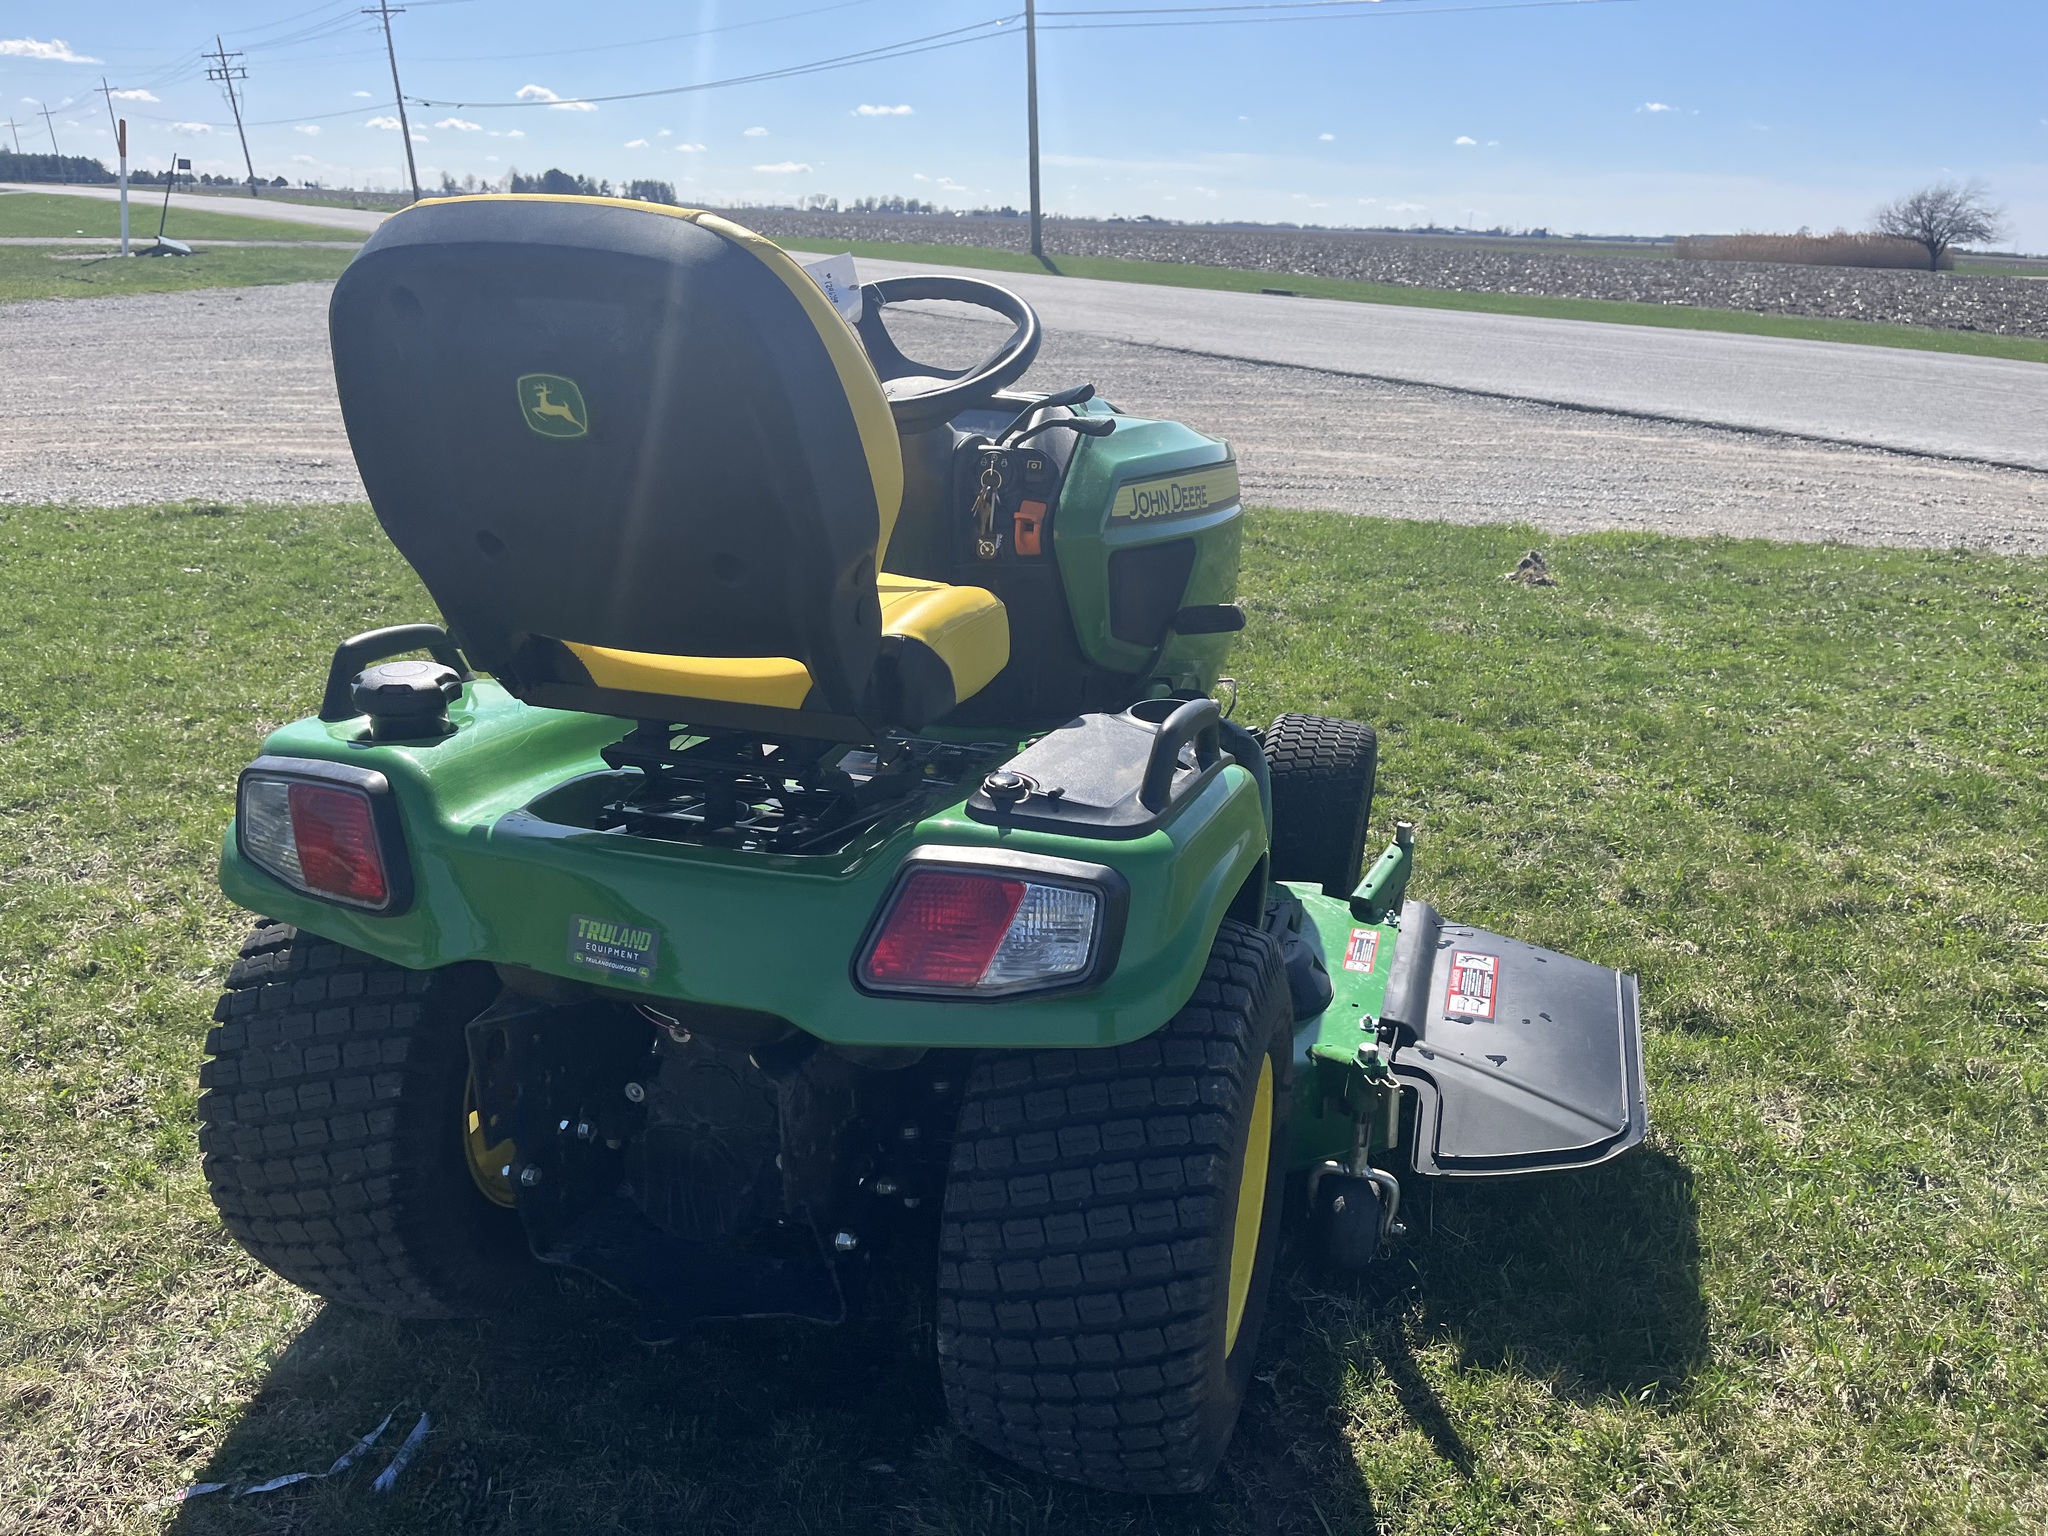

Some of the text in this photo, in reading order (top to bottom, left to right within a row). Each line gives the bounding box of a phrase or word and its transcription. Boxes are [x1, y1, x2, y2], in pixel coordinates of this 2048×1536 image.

[1130, 483, 1208, 517] JOHN DEERE
[578, 918, 652, 952] TRULAND
[585, 942, 639, 961] EQUIPMENT
[585, 956, 637, 973] TRULANDEQUIP.COM
[1451, 969, 1460, 986] DANGER
